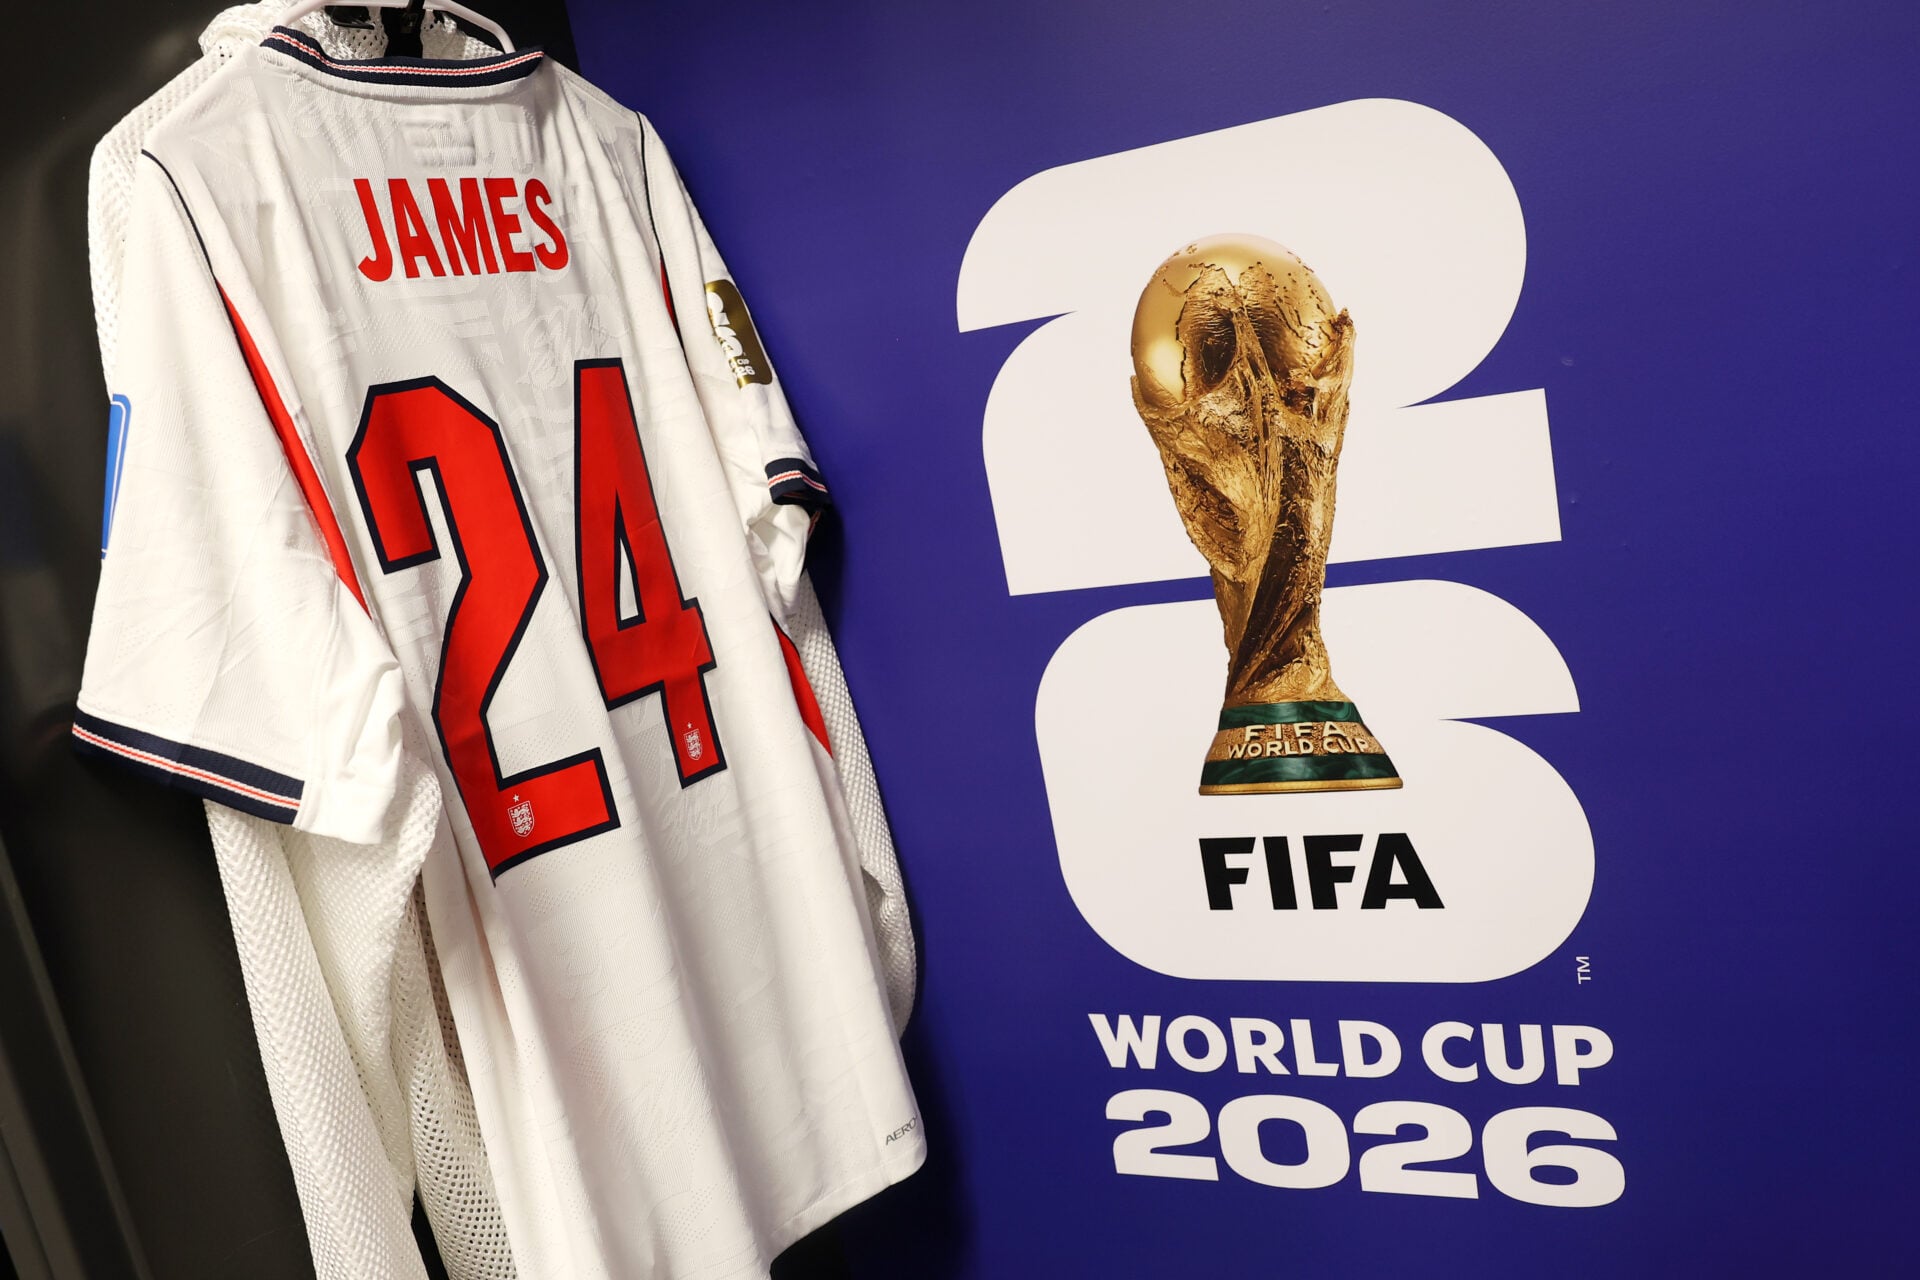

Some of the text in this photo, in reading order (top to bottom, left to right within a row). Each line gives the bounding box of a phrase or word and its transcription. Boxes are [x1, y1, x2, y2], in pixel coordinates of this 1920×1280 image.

[354, 177, 569, 282] JAMES
[345, 357, 728, 887] 24
[1227, 736, 1370, 759] WORLD CUP
[1244, 720, 1348, 742] FIFA
[1198, 832, 1445, 911] FIFA
[1576, 956, 1592, 985] TM
[1087, 1013, 1614, 1086] WORLD CUP
[1105, 1088, 1626, 1208] 2026
